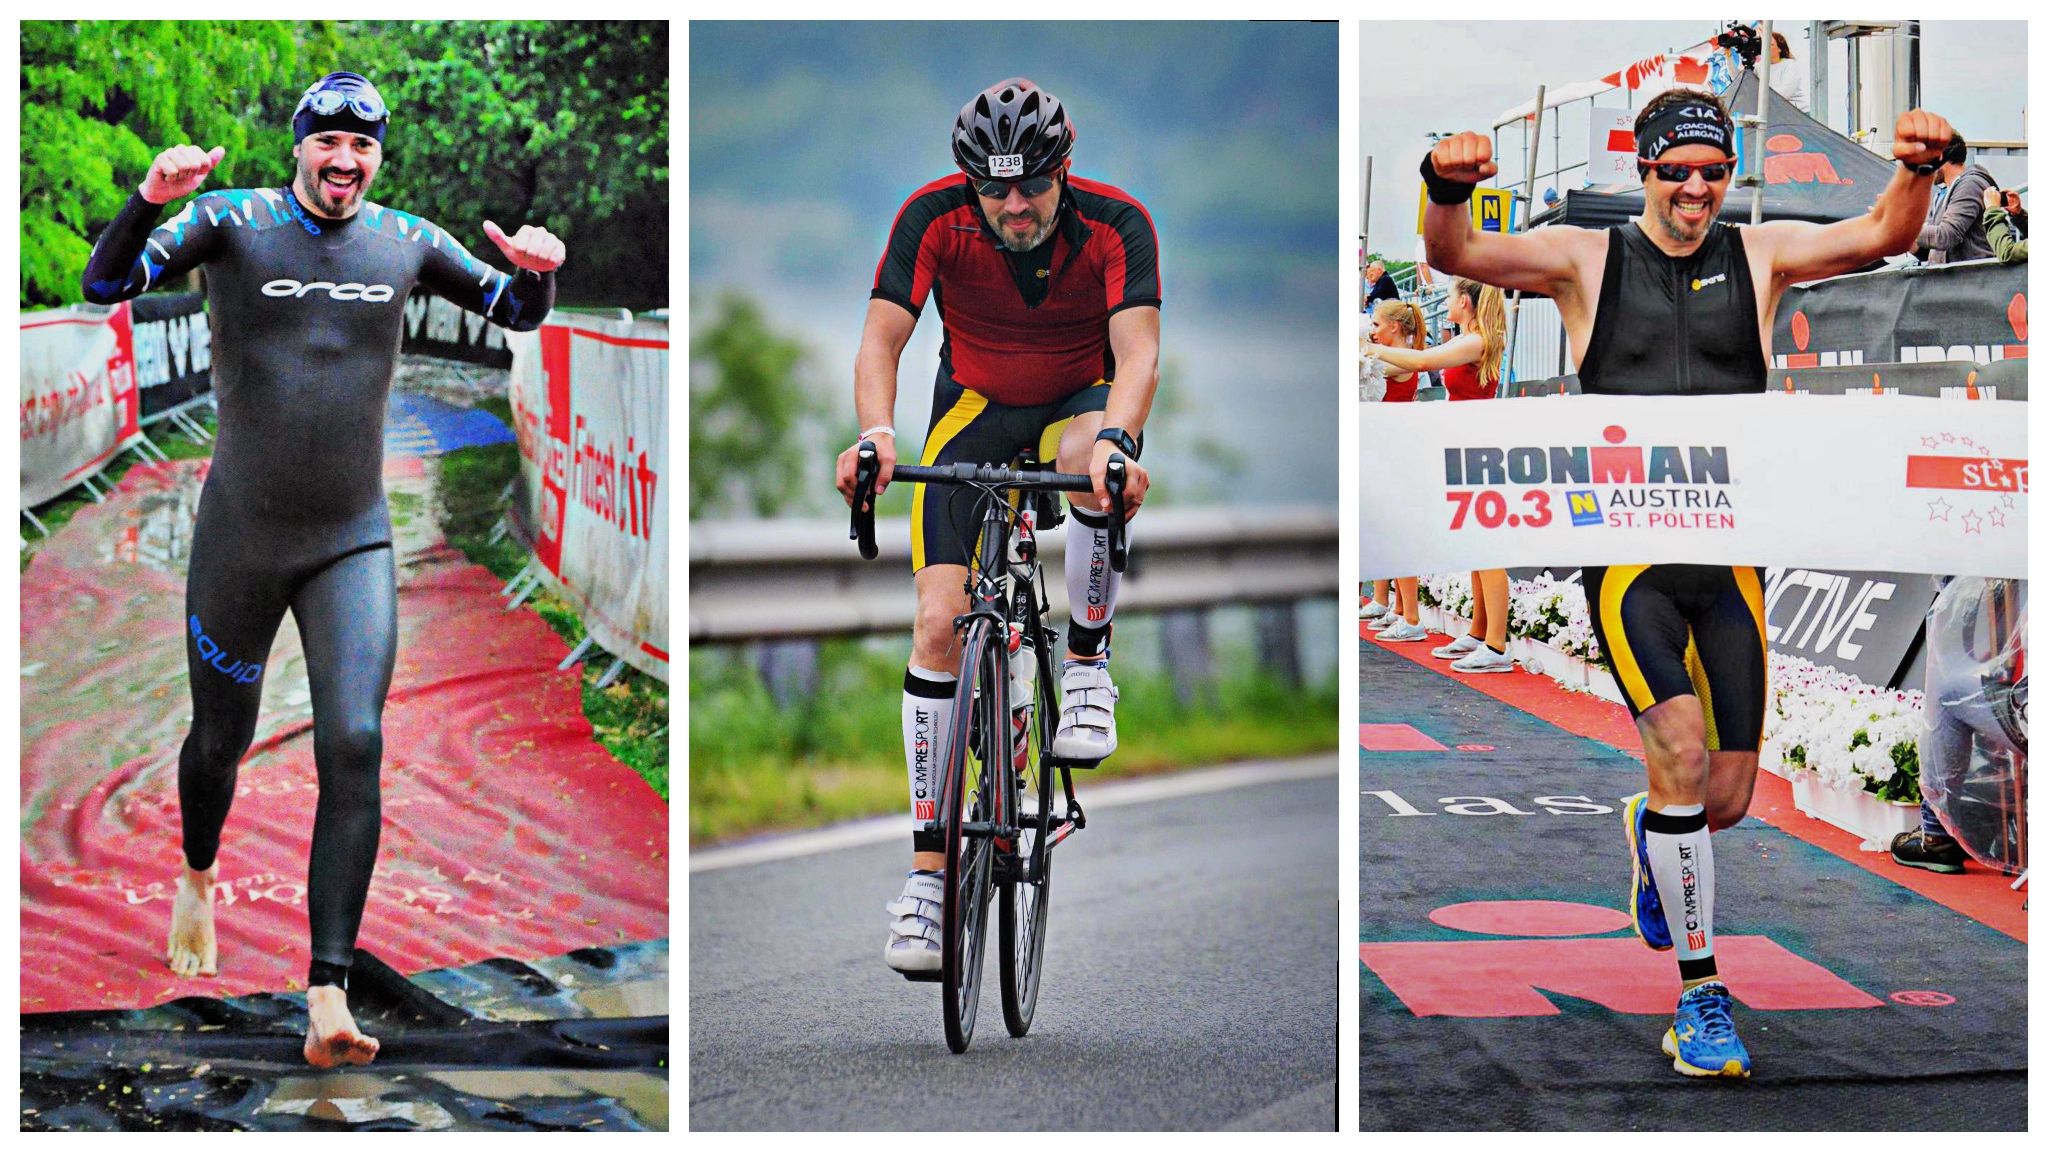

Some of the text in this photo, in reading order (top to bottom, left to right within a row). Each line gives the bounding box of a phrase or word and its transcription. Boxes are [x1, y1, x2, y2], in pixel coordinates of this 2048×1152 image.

[991, 156, 1021, 167] 1238
[261, 279, 395, 303] orca
[1444, 444, 1731, 486] IRONMAN
[1446, 489, 1553, 530] 70.3
[1609, 489, 1732, 508] AUSTRIA
[1609, 512, 1642, 528] ST.
[1649, 508, 1735, 529] PÖLTEN
[914, 709, 930, 800] COMPRESSPORT
[1361, 790, 1630, 816] las
